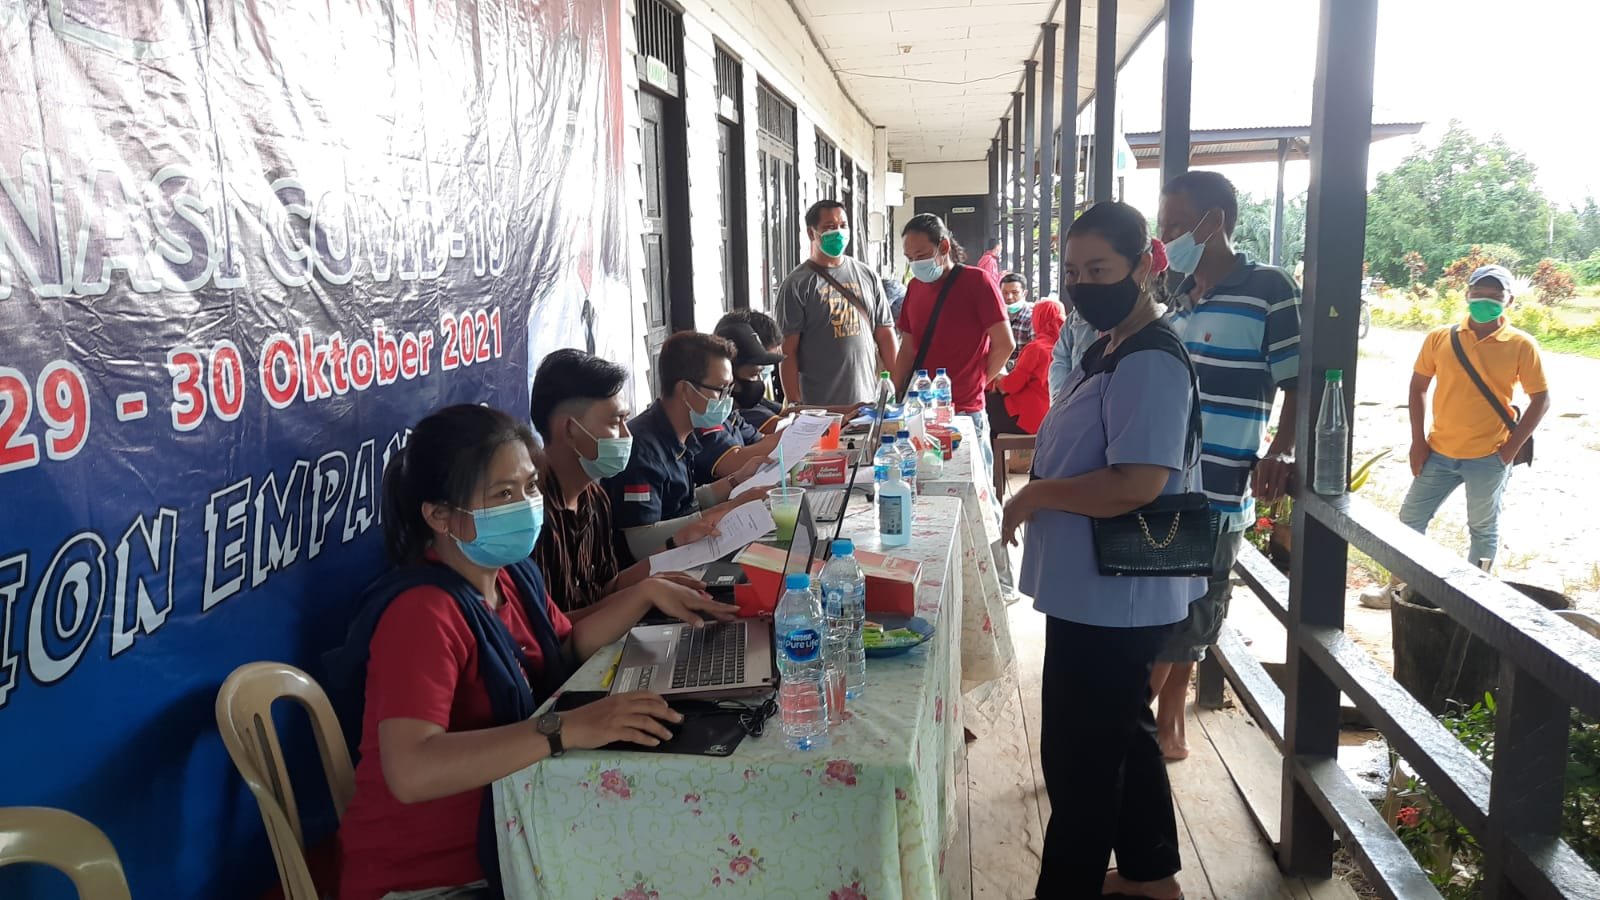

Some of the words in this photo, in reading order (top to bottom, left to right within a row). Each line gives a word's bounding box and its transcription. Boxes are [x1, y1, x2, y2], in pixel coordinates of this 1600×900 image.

[0, 358, 91, 473] 29
[168, 339, 245, 432] 30
[259, 318, 434, 410] Oktober
[440, 306, 502, 371] 2021
[785, 639, 806, 649] Pure
[806, 638, 819, 650] Life
